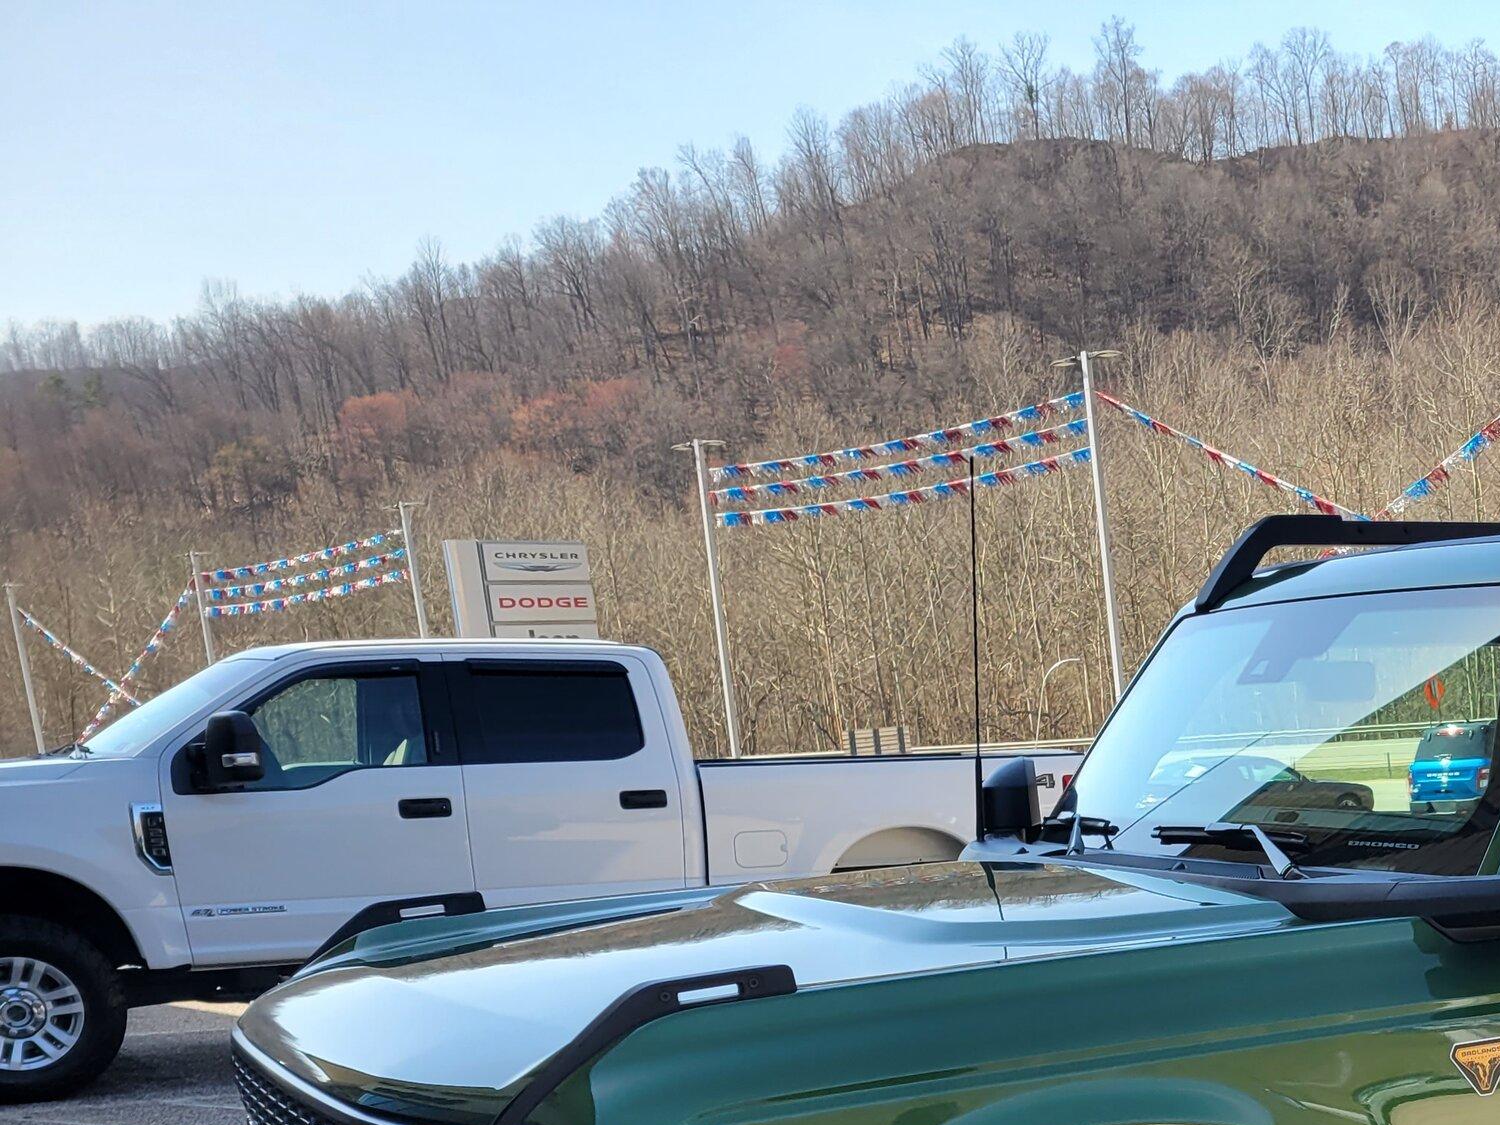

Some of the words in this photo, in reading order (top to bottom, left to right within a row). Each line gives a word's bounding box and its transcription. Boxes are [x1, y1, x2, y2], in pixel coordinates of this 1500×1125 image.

[494, 551, 579, 560] CHRYSLER
[498, 597, 589, 609] DODGE
[1348, 840, 1420, 850] BRONCO
